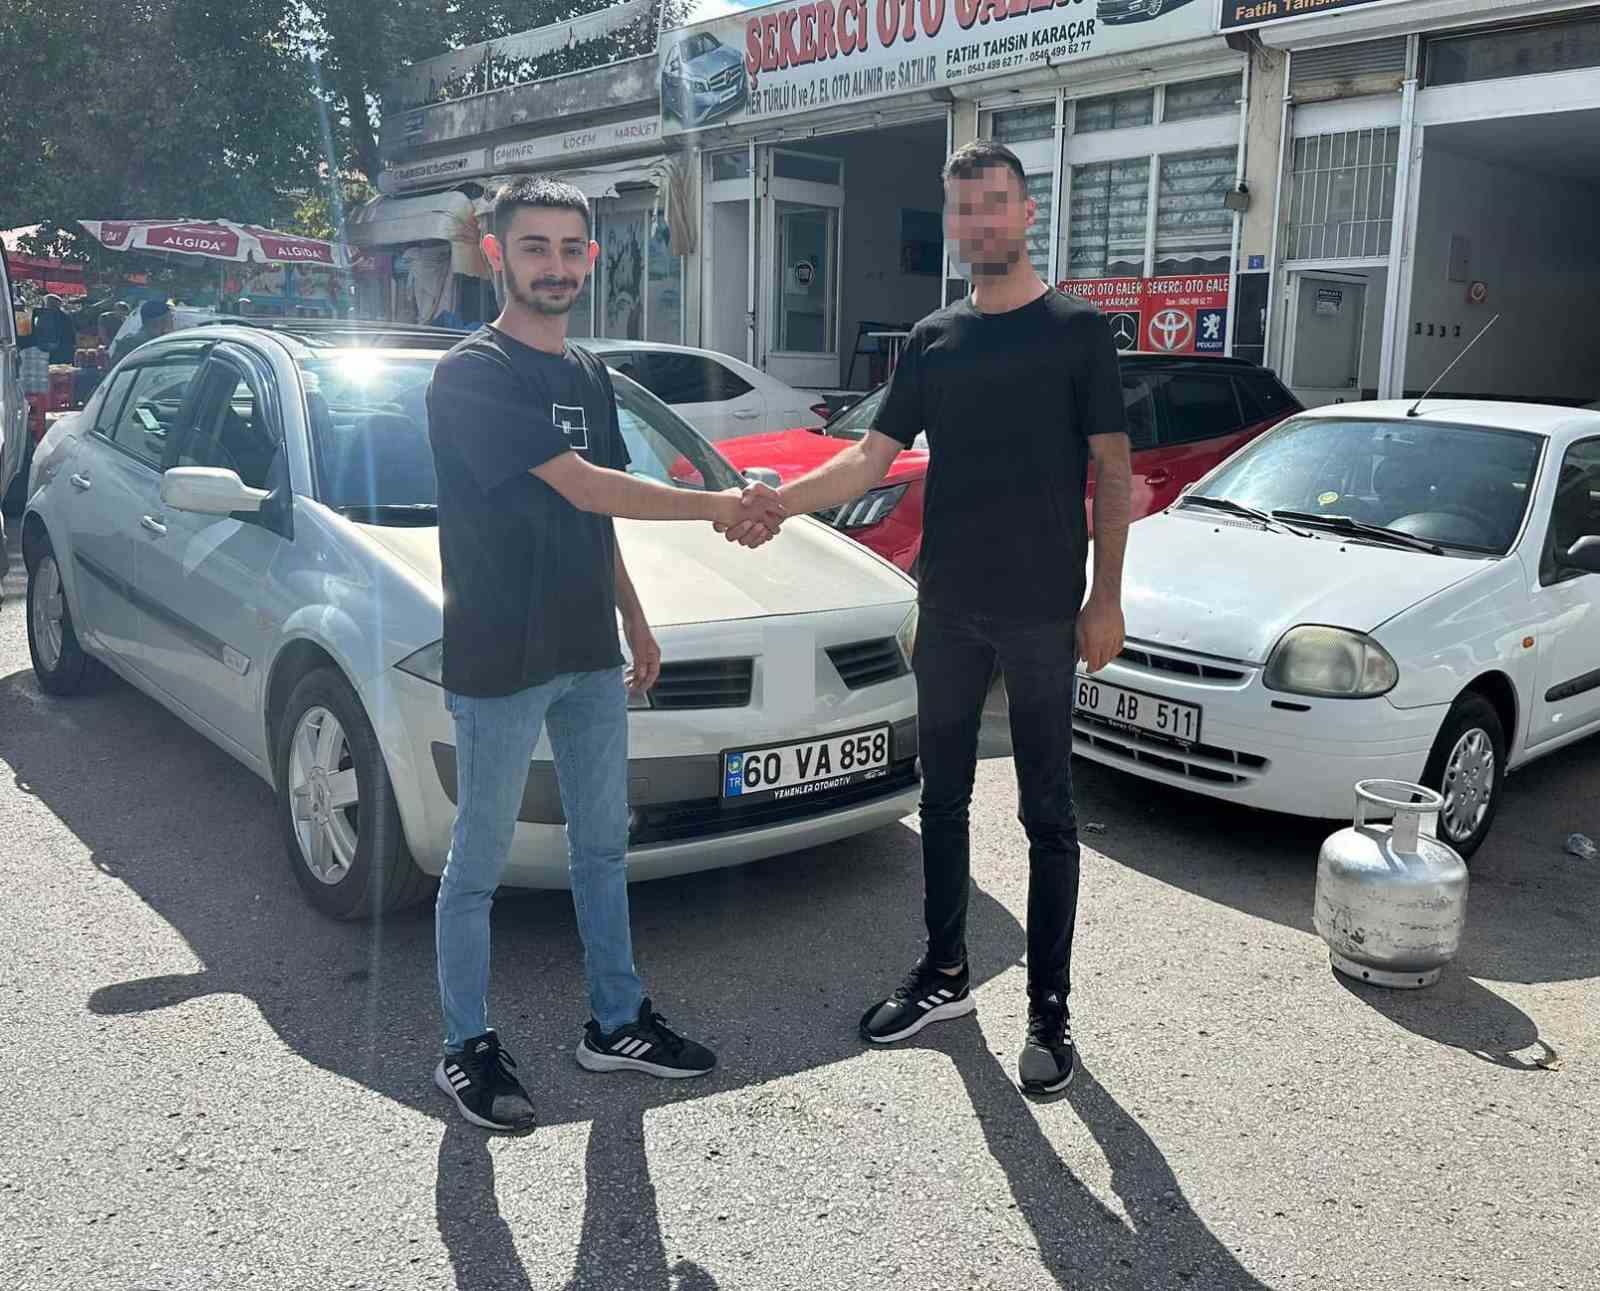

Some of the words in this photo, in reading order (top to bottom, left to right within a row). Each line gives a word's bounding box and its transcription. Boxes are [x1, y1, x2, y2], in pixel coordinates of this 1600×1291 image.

[876, 0, 946, 48] OTO
[1235, 1, 1277, 20] Fatih
[1032, 19, 1096, 47] KARAÇAR
[946, 69, 962, 79] Gsm
[968, 62, 985, 74] 0543
[1014, 54, 1023, 65] 77
[1051, 45, 1066, 58] 499
[1068, 43, 1078, 54] 62
[1080, 40, 1092, 52] 77
[763, 80, 789, 112] TÜRLÜ
[799, 87, 808, 107] ve
[820, 78, 829, 103] EL
[832, 73, 850, 100] OTO
[852, 67, 883, 97] ALINIR
[885, 71, 896, 91] ve
[163, 236, 221, 251] ALGIDA
[1097, 282, 1114, 295] OTO
[1185, 280, 1202, 293] OTO
[1078, 683, 1099, 709] 60
[1116, 693, 1138, 720] AB
[1157, 704, 1191, 736] 511
[729, 777, 741, 788] TR
[744, 752, 781, 788] 60
[796, 744, 831, 779] VA
[840, 733, 886, 769] 858
